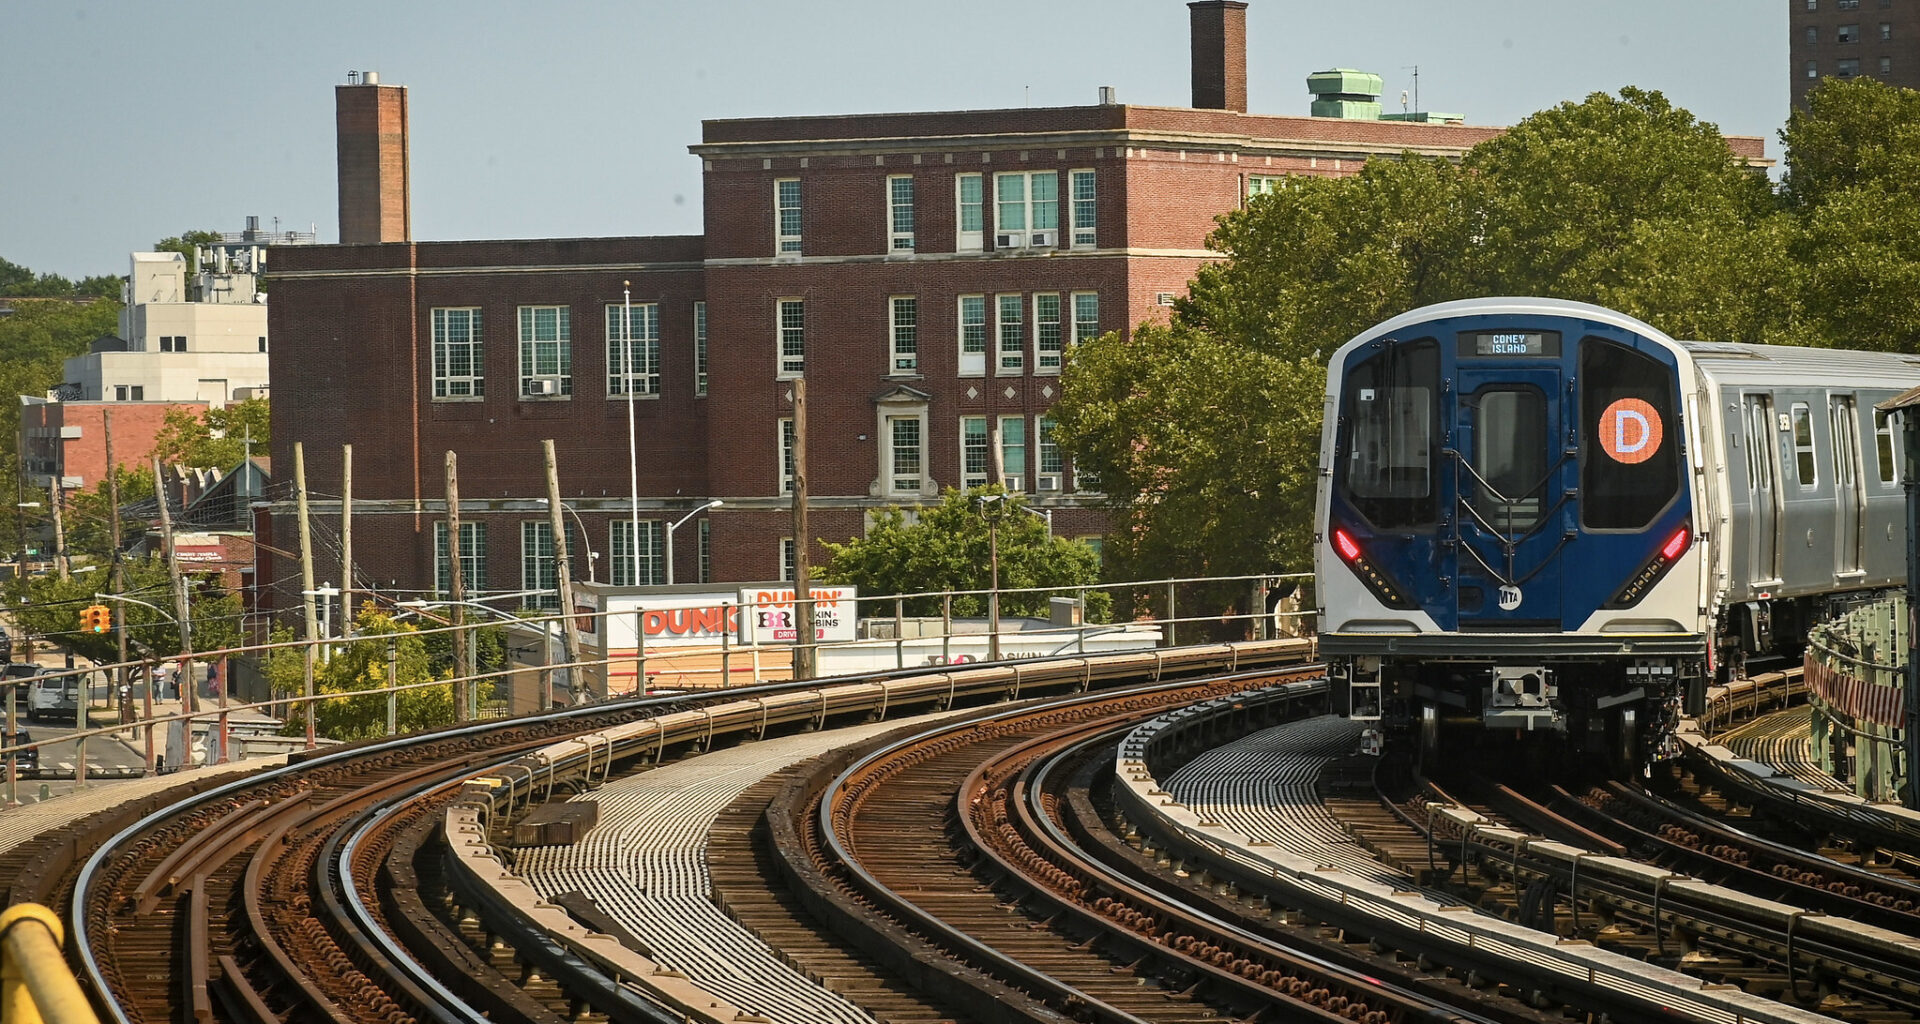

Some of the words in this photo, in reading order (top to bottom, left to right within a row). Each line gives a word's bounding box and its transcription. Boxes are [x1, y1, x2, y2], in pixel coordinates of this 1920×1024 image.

[1493, 335, 1525, 344] CONEY
[1492, 344, 1527, 353] ISLAND
[1616, 410, 1649, 452] D
[1499, 590, 1517, 604] MTA
[758, 611, 792, 628] BR
